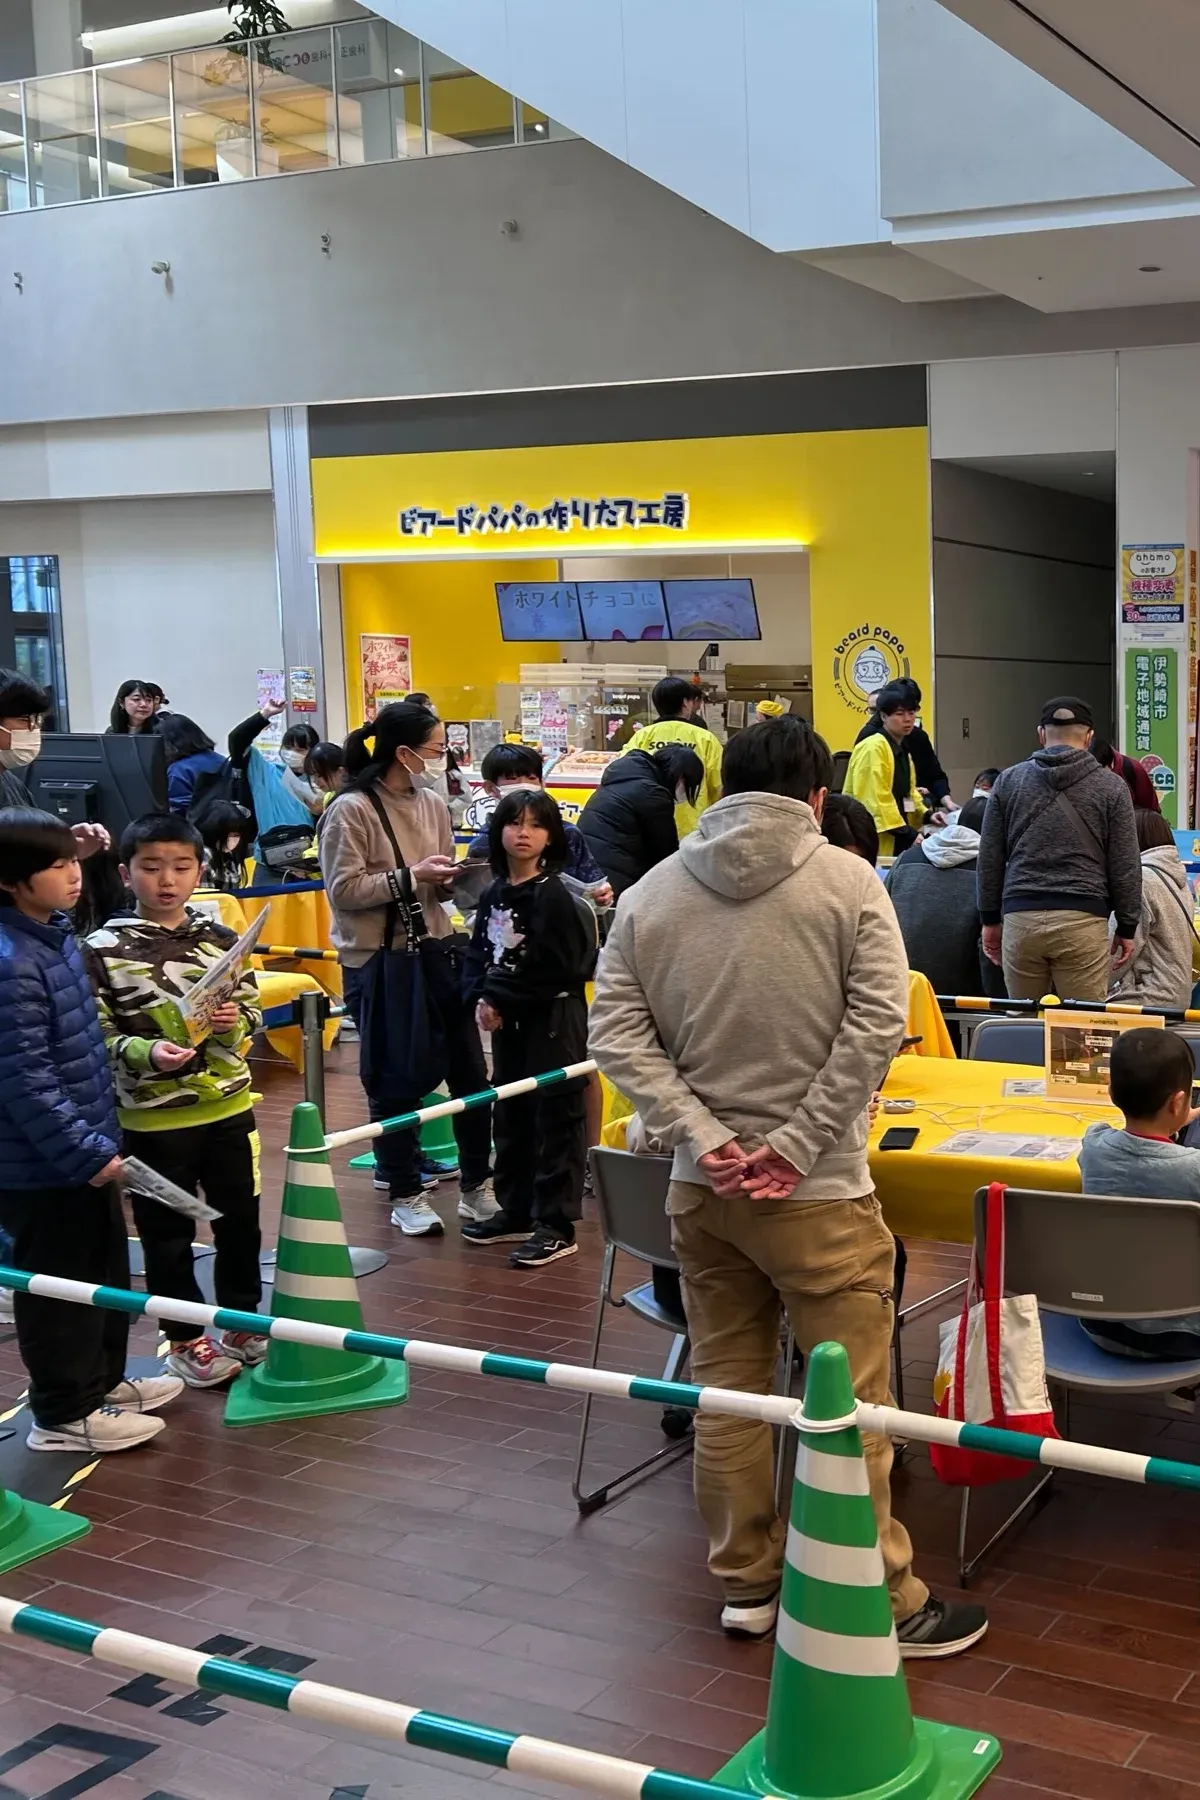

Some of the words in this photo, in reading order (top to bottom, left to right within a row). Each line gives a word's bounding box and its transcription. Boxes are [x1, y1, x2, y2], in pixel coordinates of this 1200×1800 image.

[400, 493, 687, 535] ビアードパパの作りたて工房
[1136, 553, 1170, 561] ahamo
[834, 623, 869, 654] beard
[873, 627, 904, 654] papa
[1136, 656, 1150, 751] 電子地域通貨
[1154, 657, 1167, 718] 伊勢崎市
